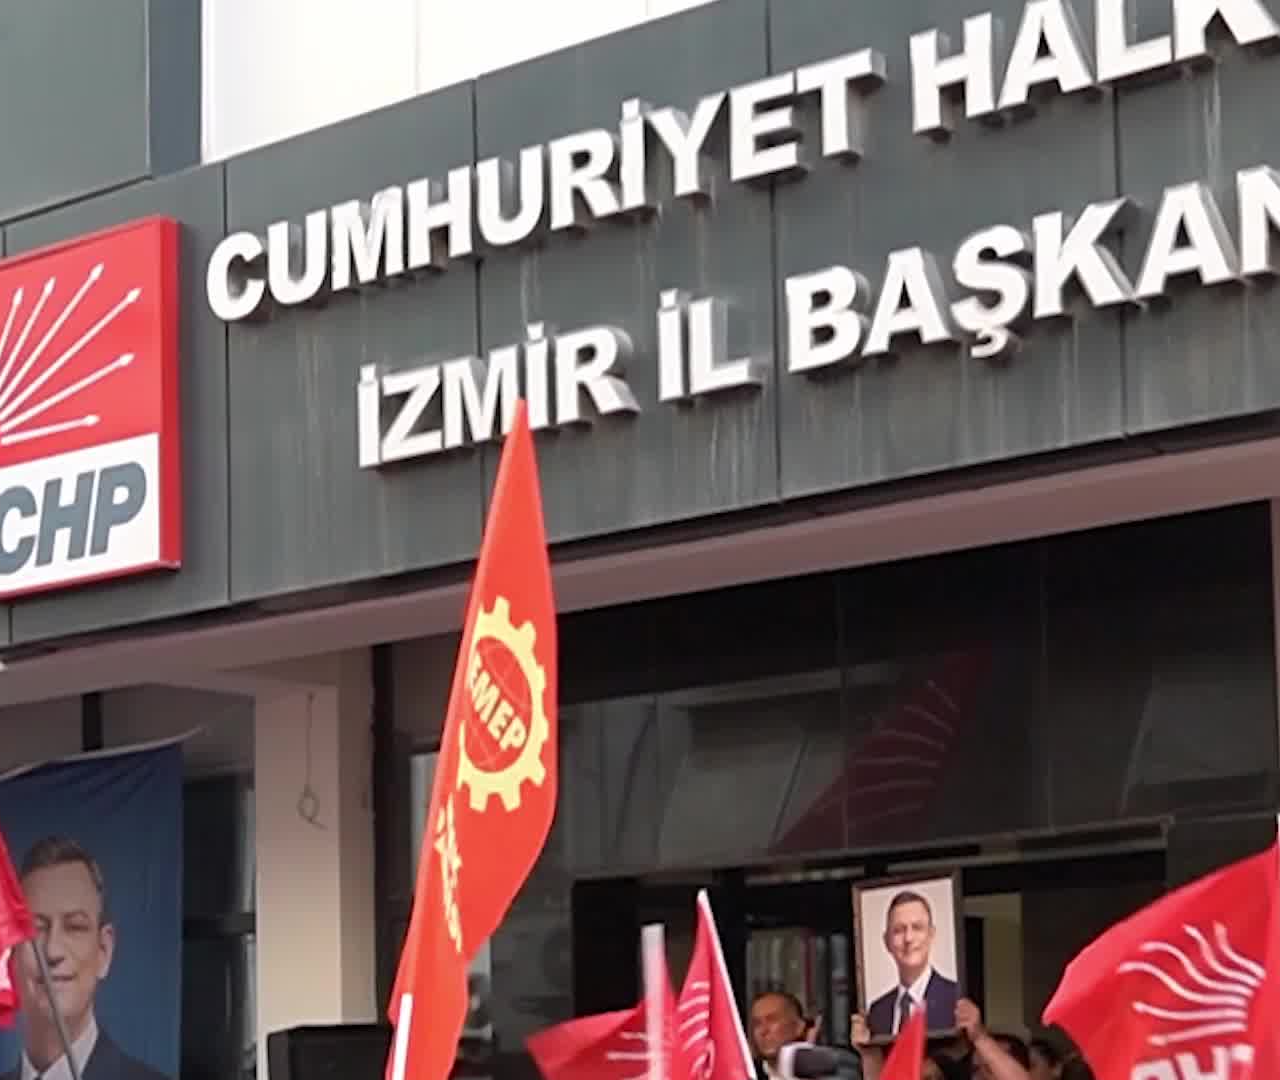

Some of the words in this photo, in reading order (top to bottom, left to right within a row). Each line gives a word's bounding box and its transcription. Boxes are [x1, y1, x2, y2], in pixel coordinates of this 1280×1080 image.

[206, 49, 884, 322] CUMHURİYET
[357, 323, 639, 469] İZMİR
[657, 289, 760, 402] İL
